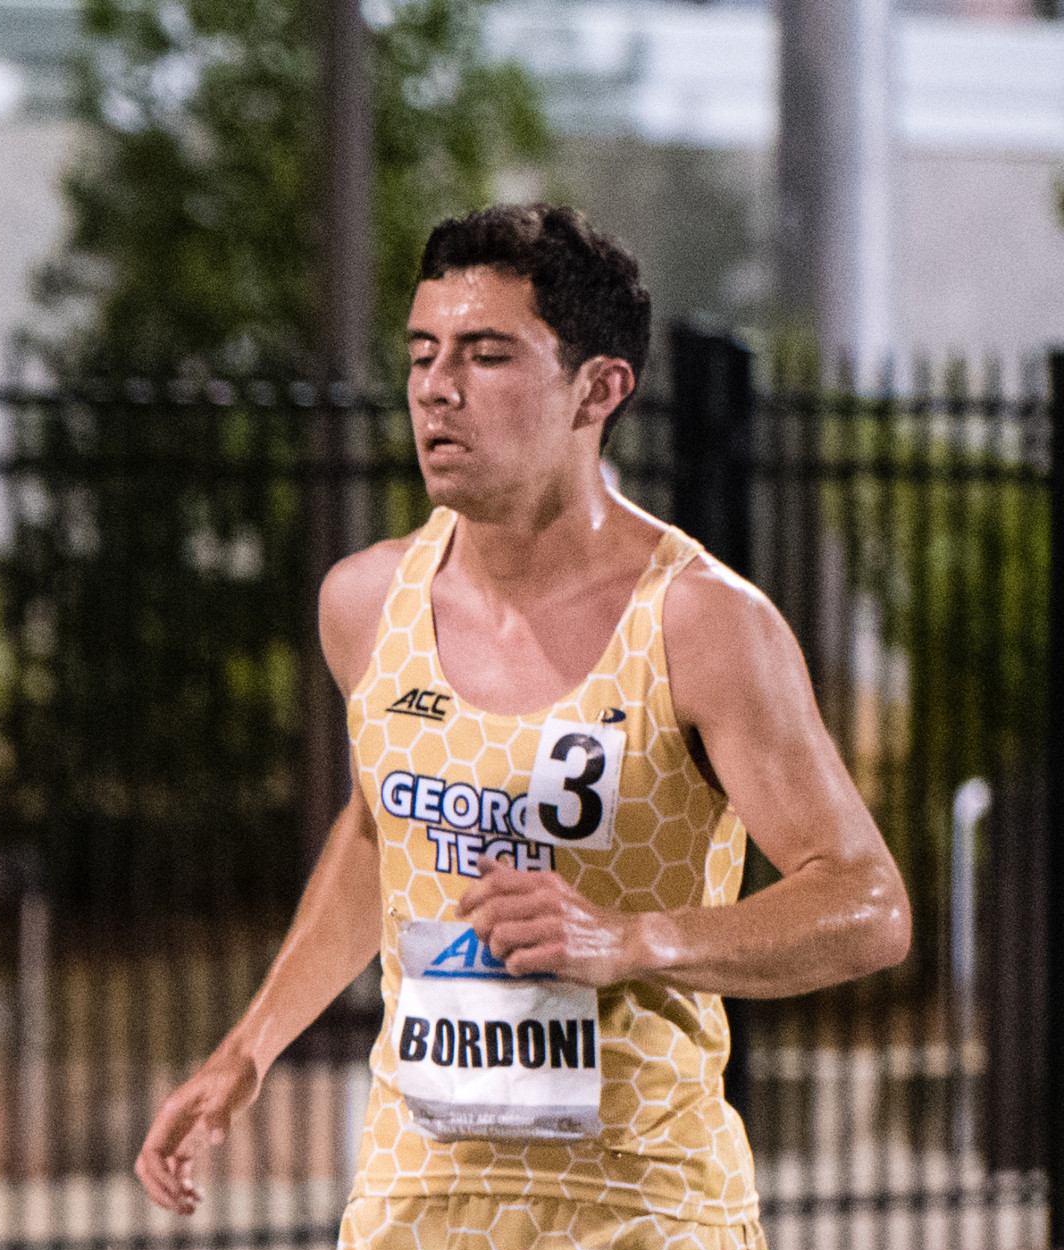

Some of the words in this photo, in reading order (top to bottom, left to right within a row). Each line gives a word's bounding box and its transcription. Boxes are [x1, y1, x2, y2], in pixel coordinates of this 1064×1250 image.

[392, 688, 451, 716] ACC
[539, 732, 606, 841] 3
[399, 1016, 596, 1069] BORDONI
